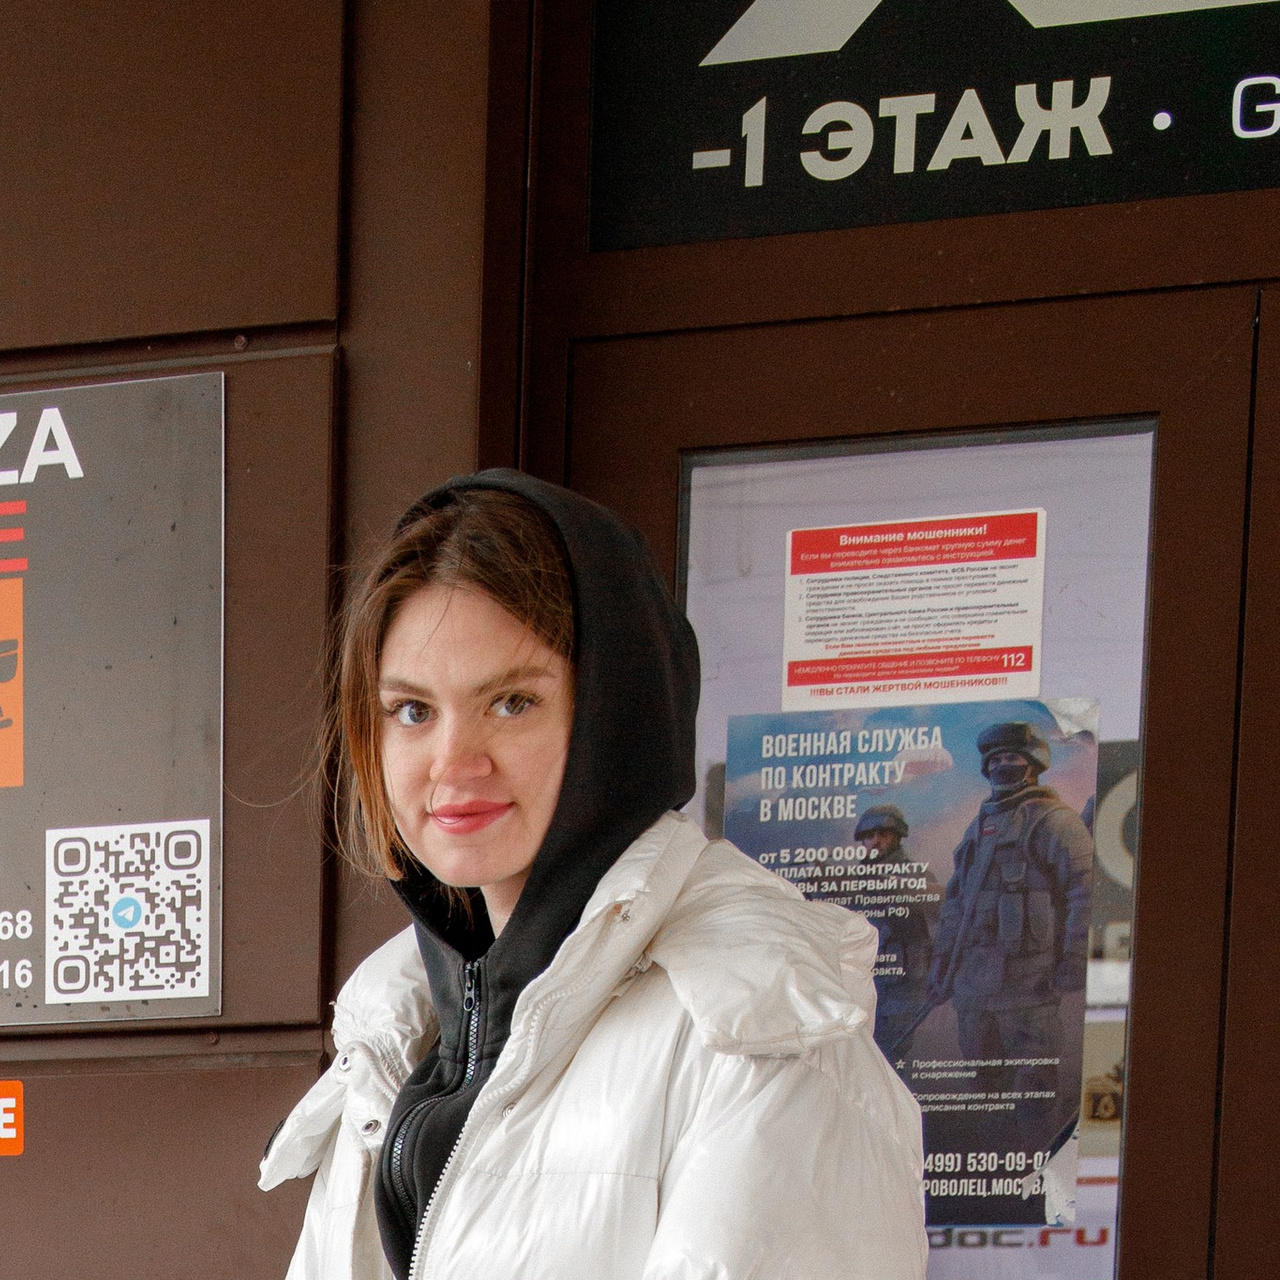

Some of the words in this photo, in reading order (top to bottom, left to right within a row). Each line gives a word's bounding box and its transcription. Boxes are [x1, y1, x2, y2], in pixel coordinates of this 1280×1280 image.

[692, 96, 767, 187] -1
[799, 75, 1113, 181] ЭТАЖ
[839, 532, 904, 545] Внимание
[906, 524, 987, 540] мошенники!
[1001, 653, 1025, 668] 112
[835, 685, 869, 695] СТАЛИ
[872, 682, 921, 692] ЖЕРТВОЙ
[924, 676, 1007, 689] МОШЕННИКОВ!!!
[762, 731, 851, 758] ВОЕННАЯ
[858, 726, 942, 754] СЛУЖБА
[761, 766, 786, 790] ПО
[792, 761, 906, 788] КОНТРАКТУ
[760, 799, 771, 822] В
[778, 795, 857, 821] МОСКВЕ
[759, 852, 777, 864] от
[780, 849, 790, 863] 5
[794, 848, 828, 863] 200
[833, 846, 867, 862] 000
[825, 865, 844, 877] ПО
[847, 862, 929, 876] КОНТРАКТУ
[820, 880, 838, 892] ЗА
[840, 876, 897, 891] ПЕРВЫЙ
[900, 877, 927, 890] ГОД
[855, 893, 940, 906] Правительства
[888, 907, 910, 918] РФ)
[912, 1059, 1002, 1070] Профессиональная
[920, 1070, 977, 1080] снаряжение
[967, 1151, 1051, 1172] 530-09-01
